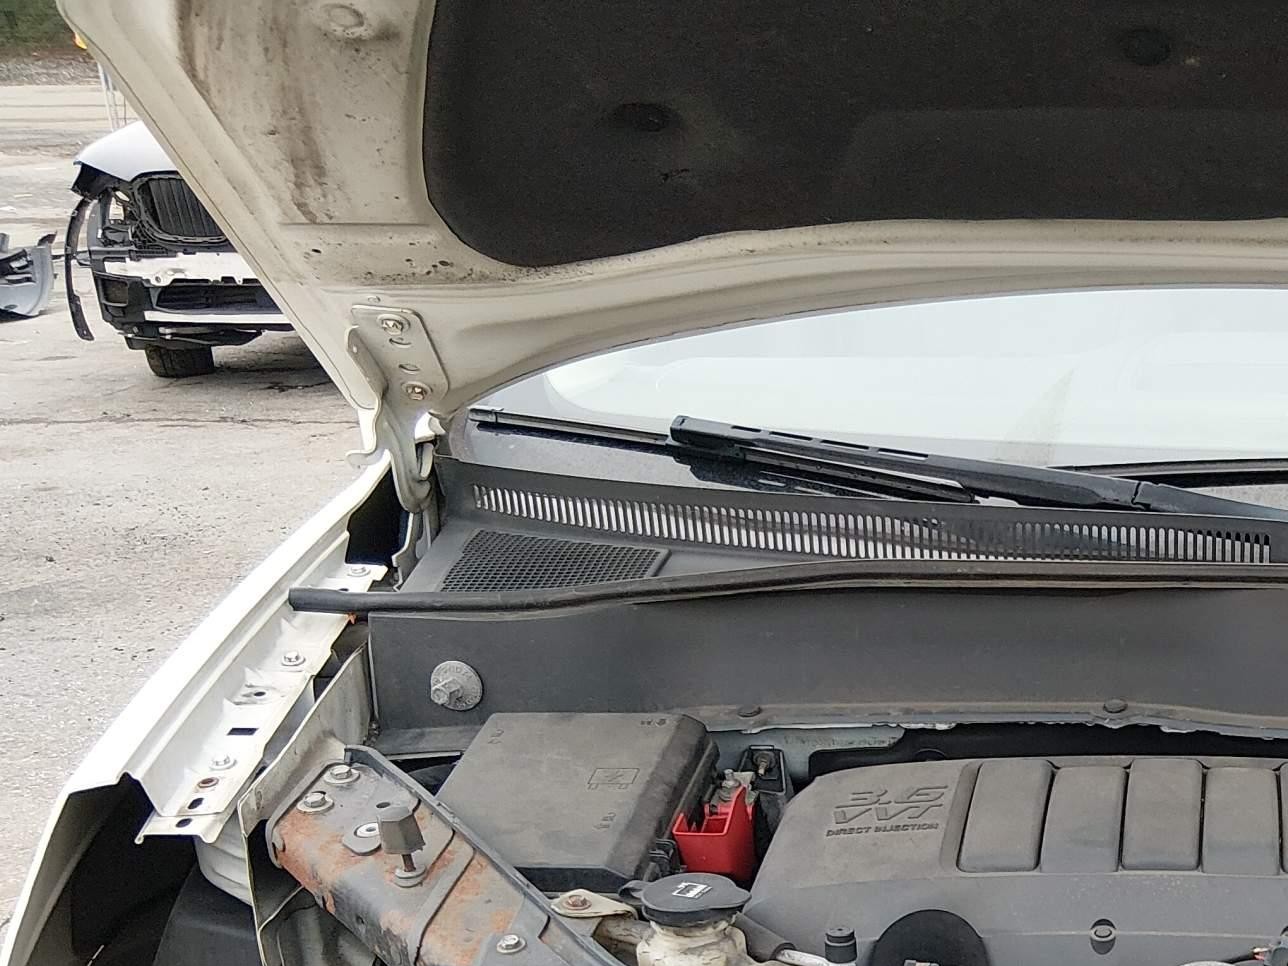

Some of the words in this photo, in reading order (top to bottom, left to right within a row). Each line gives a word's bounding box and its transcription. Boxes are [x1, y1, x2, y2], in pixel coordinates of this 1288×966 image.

[834, 803, 944, 824] VVT
[825, 826, 872, 837] DIRECT
[873, 823, 939, 835] INJECTION
